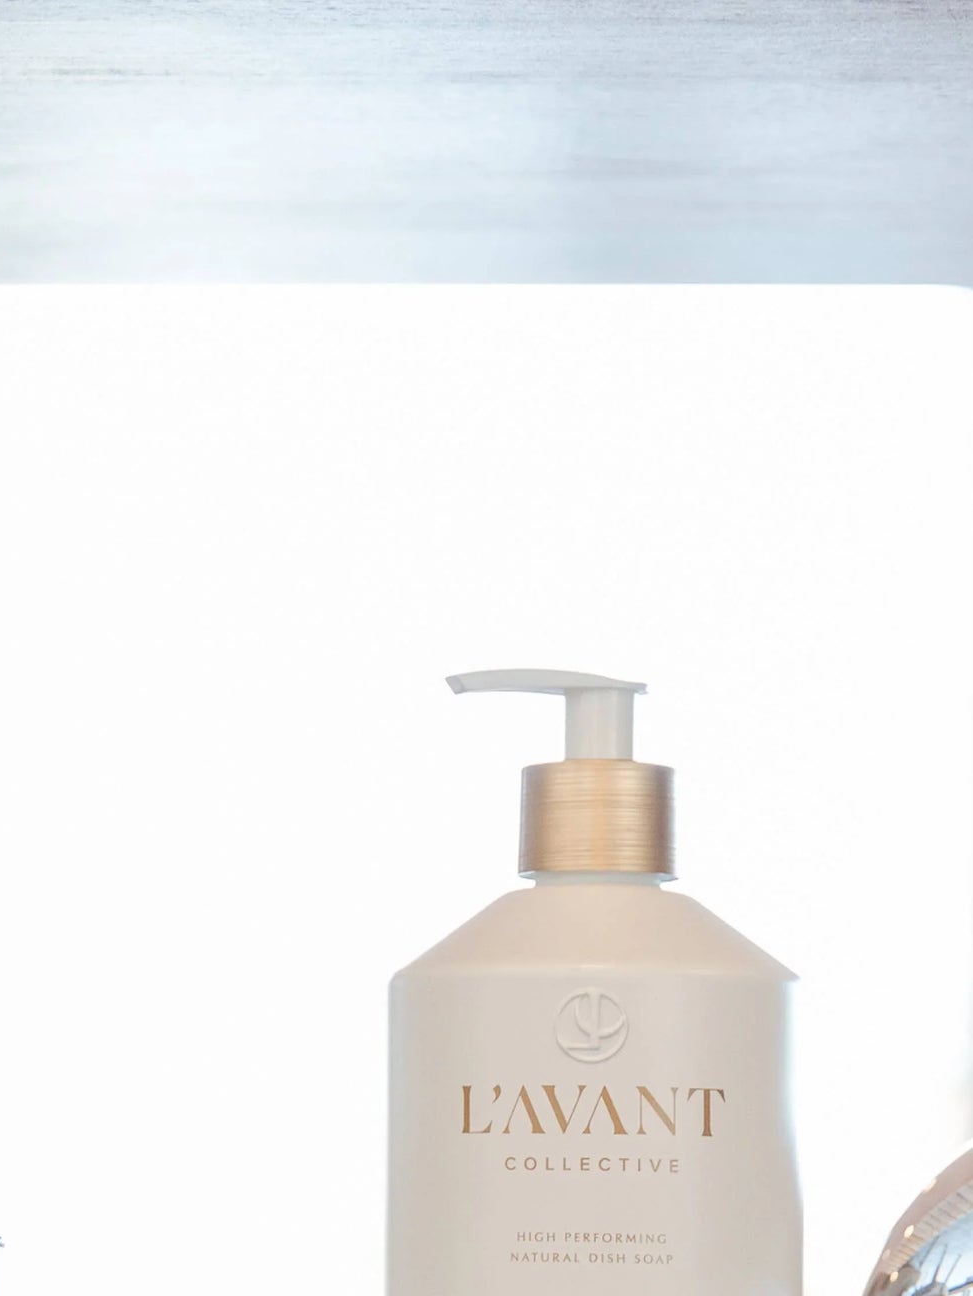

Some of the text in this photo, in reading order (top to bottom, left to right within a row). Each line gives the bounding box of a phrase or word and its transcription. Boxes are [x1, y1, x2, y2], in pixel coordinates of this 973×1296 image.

[461, 1084, 726, 1138] L'AVANT
[504, 1156, 679, 1174] COLLECTIVE
[516, 1231, 667, 1244] HIGH PERFORMING
[510, 1252, 674, 1265] NATURAL DISH SOAP
